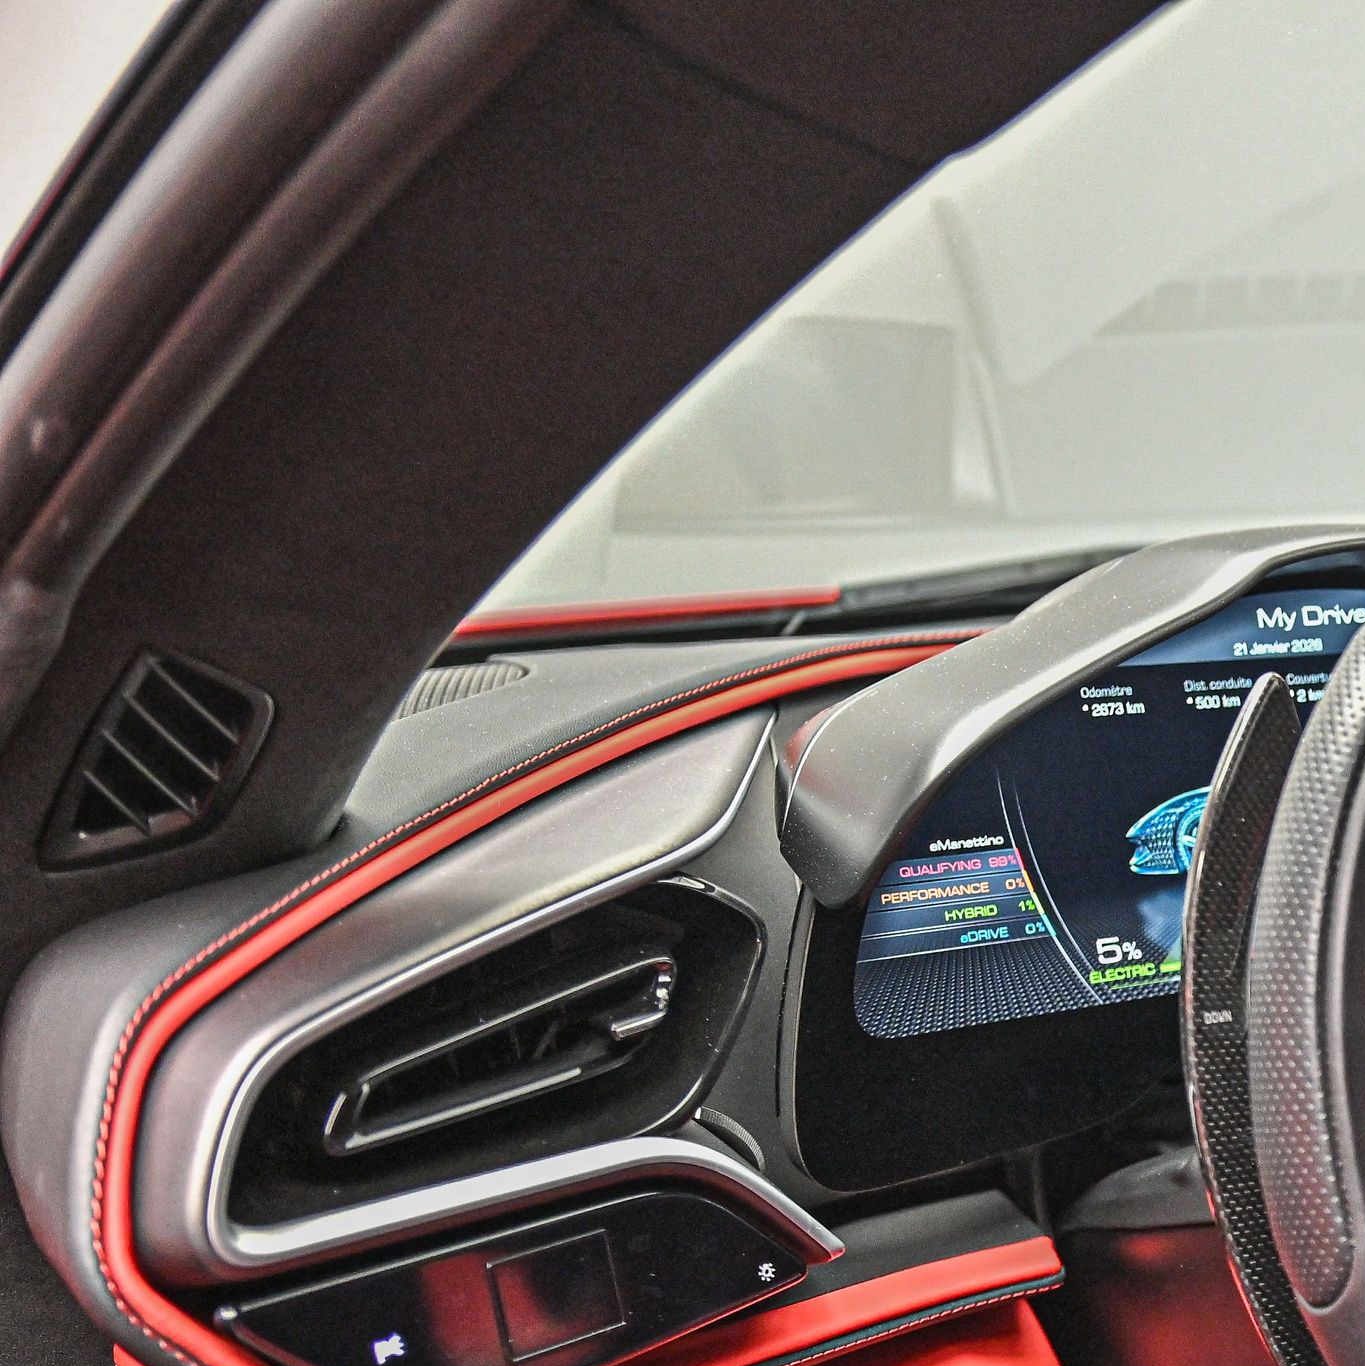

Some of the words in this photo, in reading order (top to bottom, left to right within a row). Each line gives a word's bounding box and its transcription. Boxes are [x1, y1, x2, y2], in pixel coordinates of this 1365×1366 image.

[1256, 606, 1296, 631] My
[1233, 641, 1248, 656] 21
[1080, 684, 1133, 699] Odomètre
[1209, 676, 1253, 691] conduite
[1125, 701, 1146, 715] km
[1194, 696, 1221, 710] 500
[1222, 695, 1241, 708] km
[929, 834, 1005, 853] eManettino
[899, 858, 982, 878] QUALIFYING
[880, 881, 990, 905] PERFORMANCE
[1004, 877, 1026, 891] 0%
[944, 904, 999, 922] HYBRID
[960, 926, 1010, 945] eDRIVE
[1025, 921, 1046, 935] 0%
[1095, 936, 1143, 965] 5%
[1089, 962, 1156, 985] ELECTRIC
[1203, 1010, 1233, 1025] DOWN
